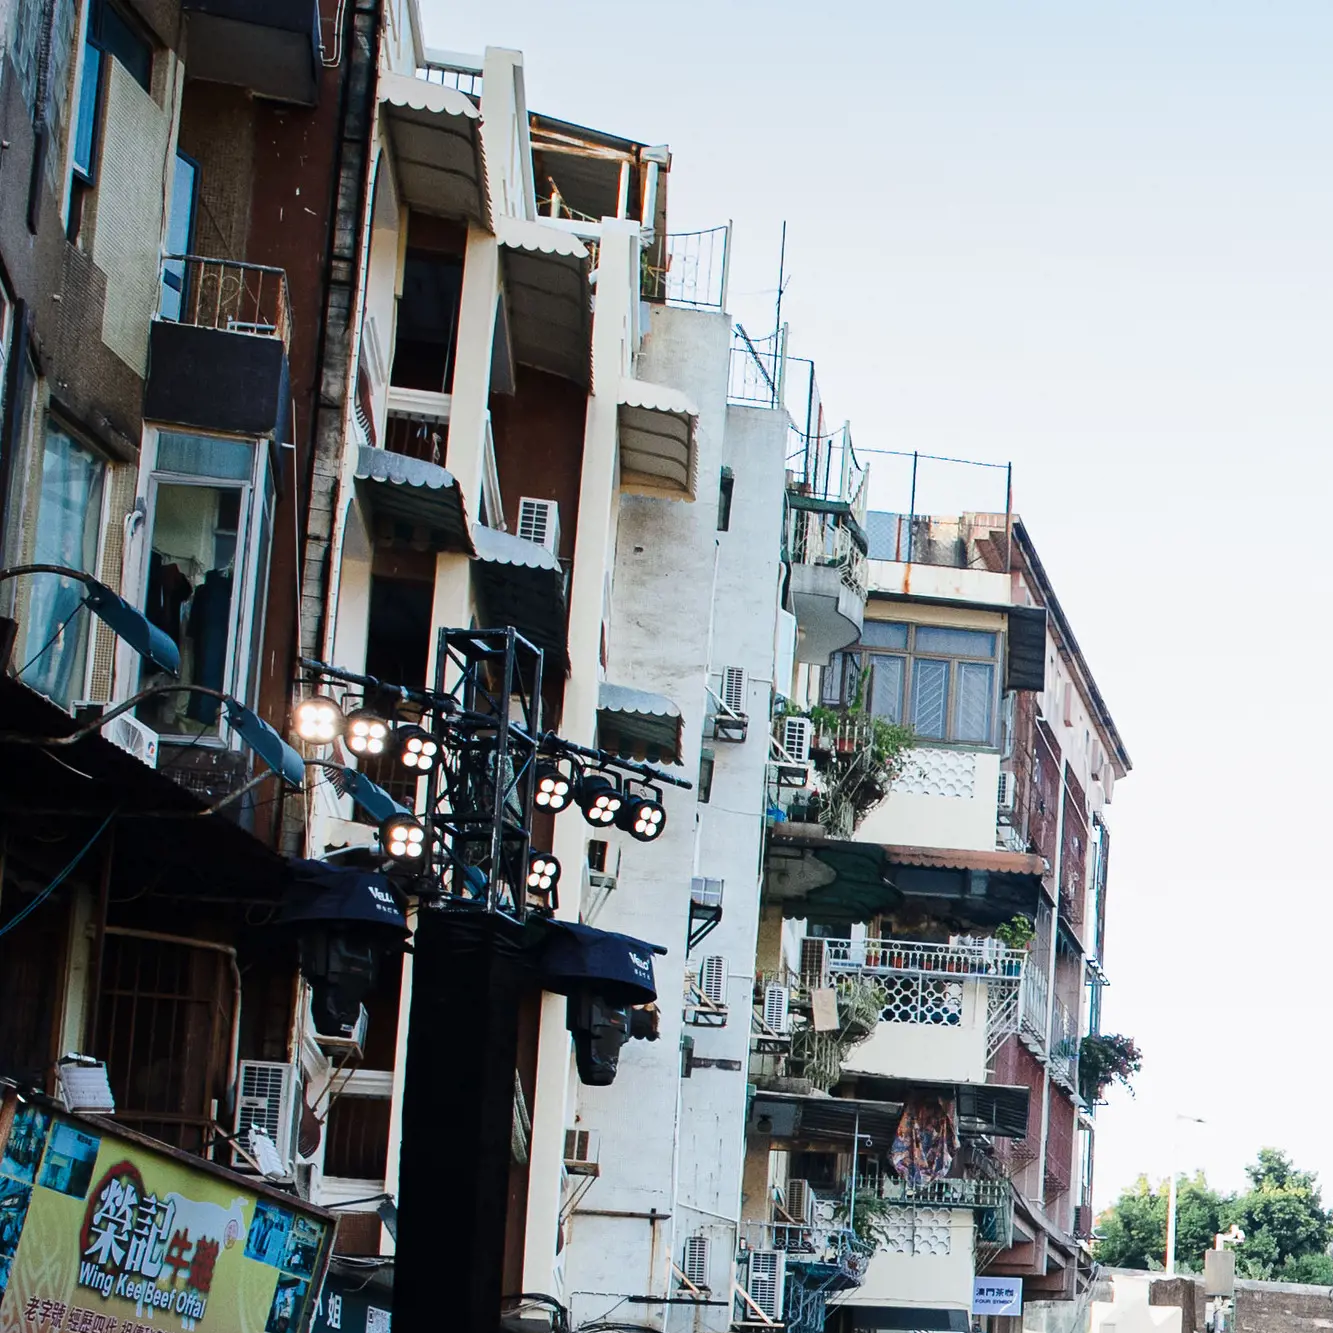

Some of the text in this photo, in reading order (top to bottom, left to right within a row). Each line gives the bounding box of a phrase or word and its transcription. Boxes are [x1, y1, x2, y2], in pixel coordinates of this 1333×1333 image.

[84, 1178, 176, 1278] 榮記
[79, 1261, 207, 1319] Wing Kee Beef Offal
